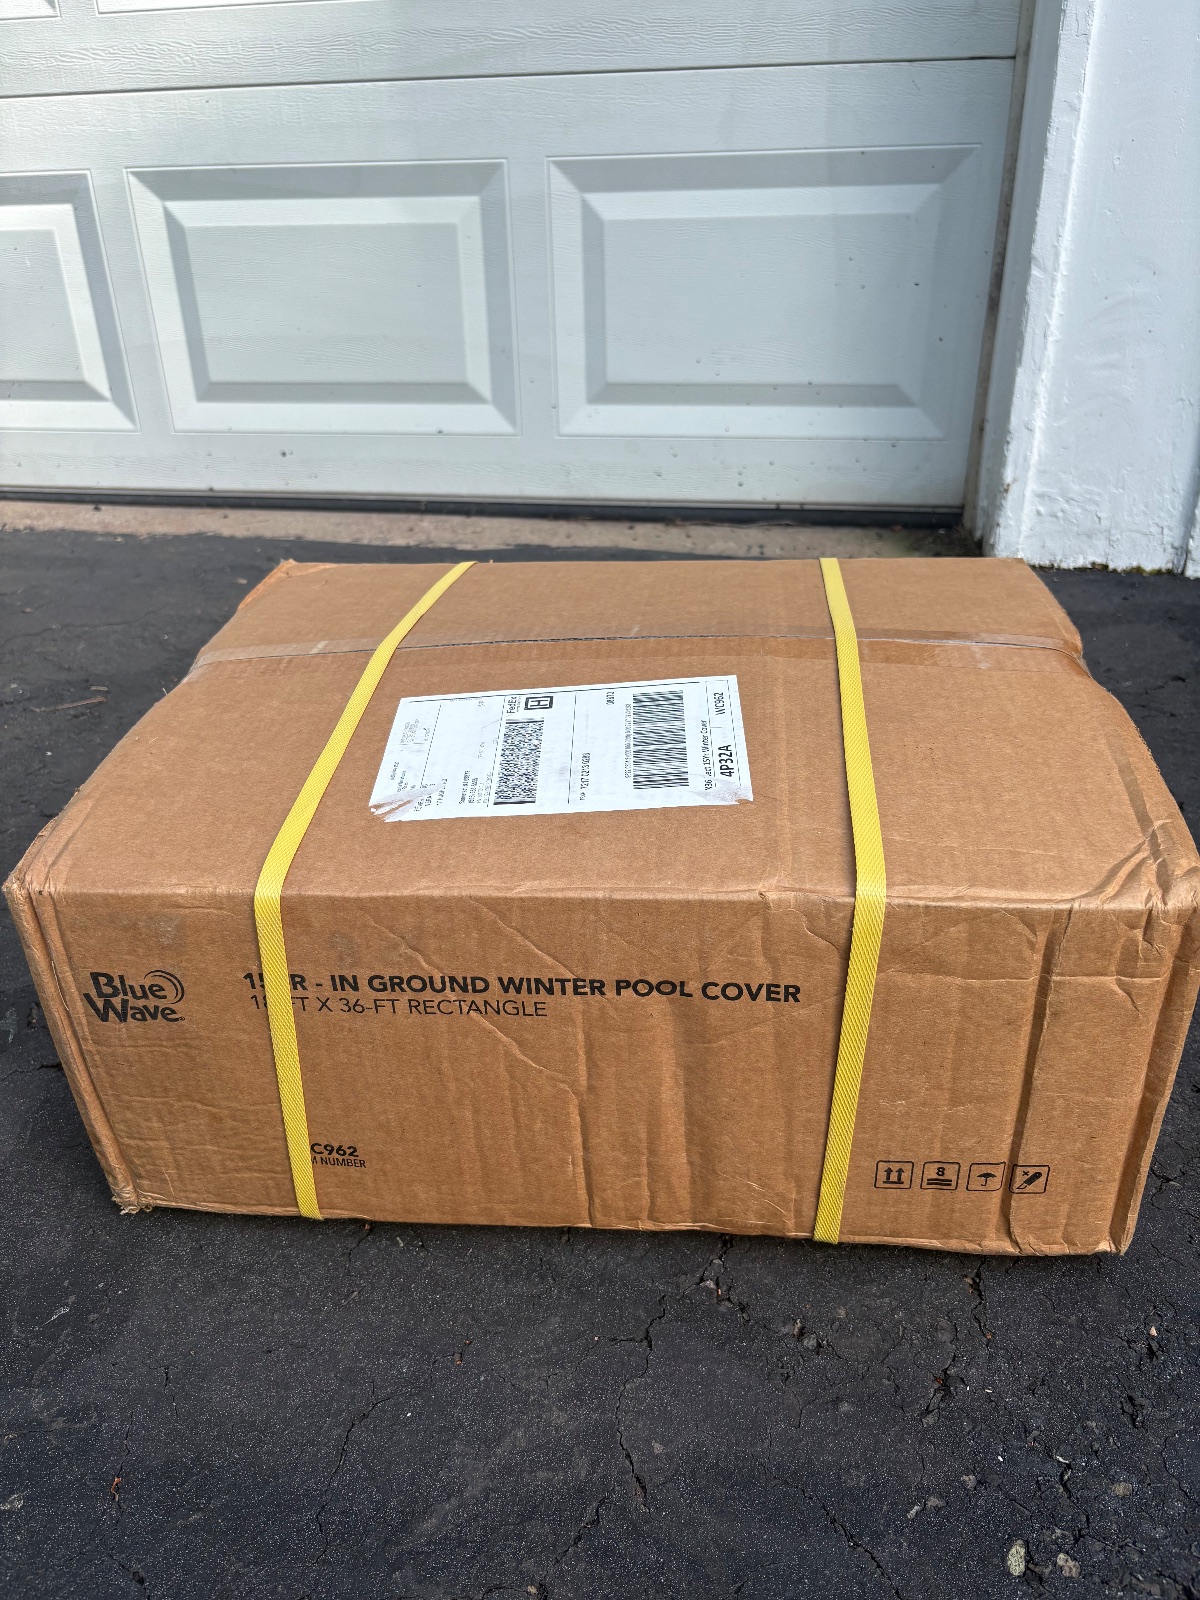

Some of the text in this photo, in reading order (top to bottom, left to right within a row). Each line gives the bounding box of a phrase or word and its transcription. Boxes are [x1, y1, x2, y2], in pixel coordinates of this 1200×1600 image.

[506, 696, 517, 714] FedEx
[699, 719, 708, 734] Cover
[713, 691, 735, 778] 4P32A WC962
[700, 734, 710, 753] Winter
[90, 972, 167, 1000] Blue
[243, 973, 308, 991] 1R
[330, 974, 360, 992] IN
[367, 974, 490, 993] GROUND
[498, 976, 606, 996] WINTER
[615, 978, 694, 998] POOL
[701, 981, 800, 1002] COVER
[83, 993, 180, 1022] Wave
[316, 996, 334, 1012] X
[338, 997, 400, 1014] 36-FT
[408, 998, 548, 1017] RECTANGLE
[310, 1142, 360, 1158] C962
[320, 1156, 367, 1169] NUMBER
